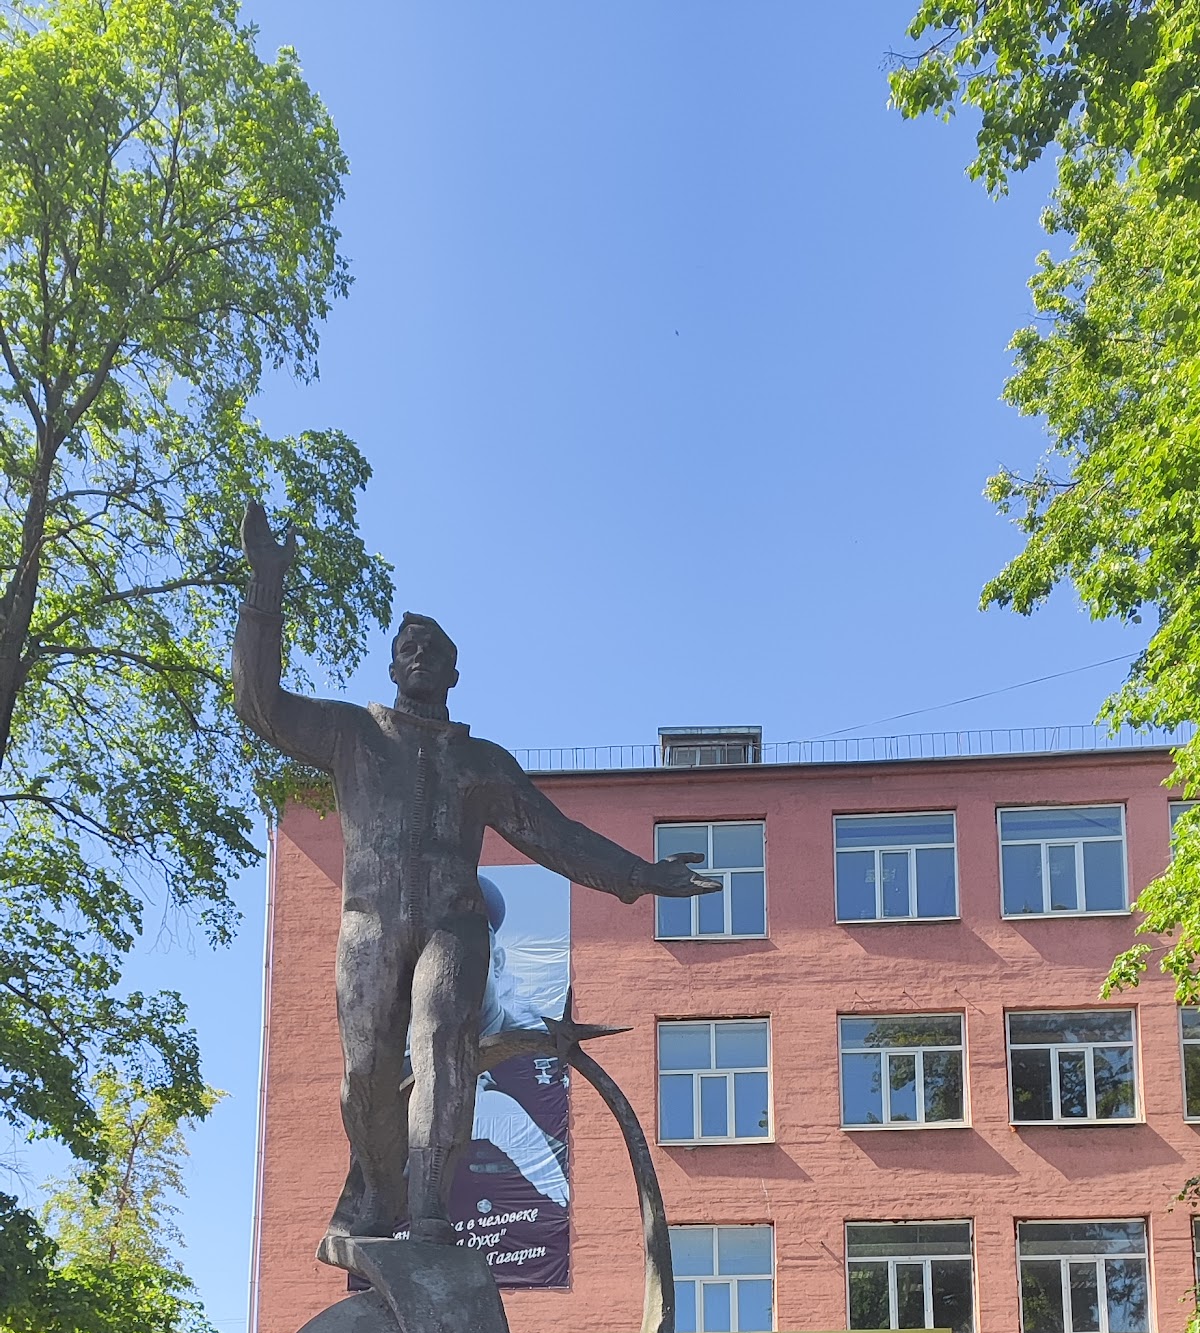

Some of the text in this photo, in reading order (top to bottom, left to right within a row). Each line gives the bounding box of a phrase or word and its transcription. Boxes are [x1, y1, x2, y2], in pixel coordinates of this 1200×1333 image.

[467, 1219, 475, 1230] в
[478, 1208, 539, 1227] человеке
[486, 1246, 546, 1266] Гагарин
